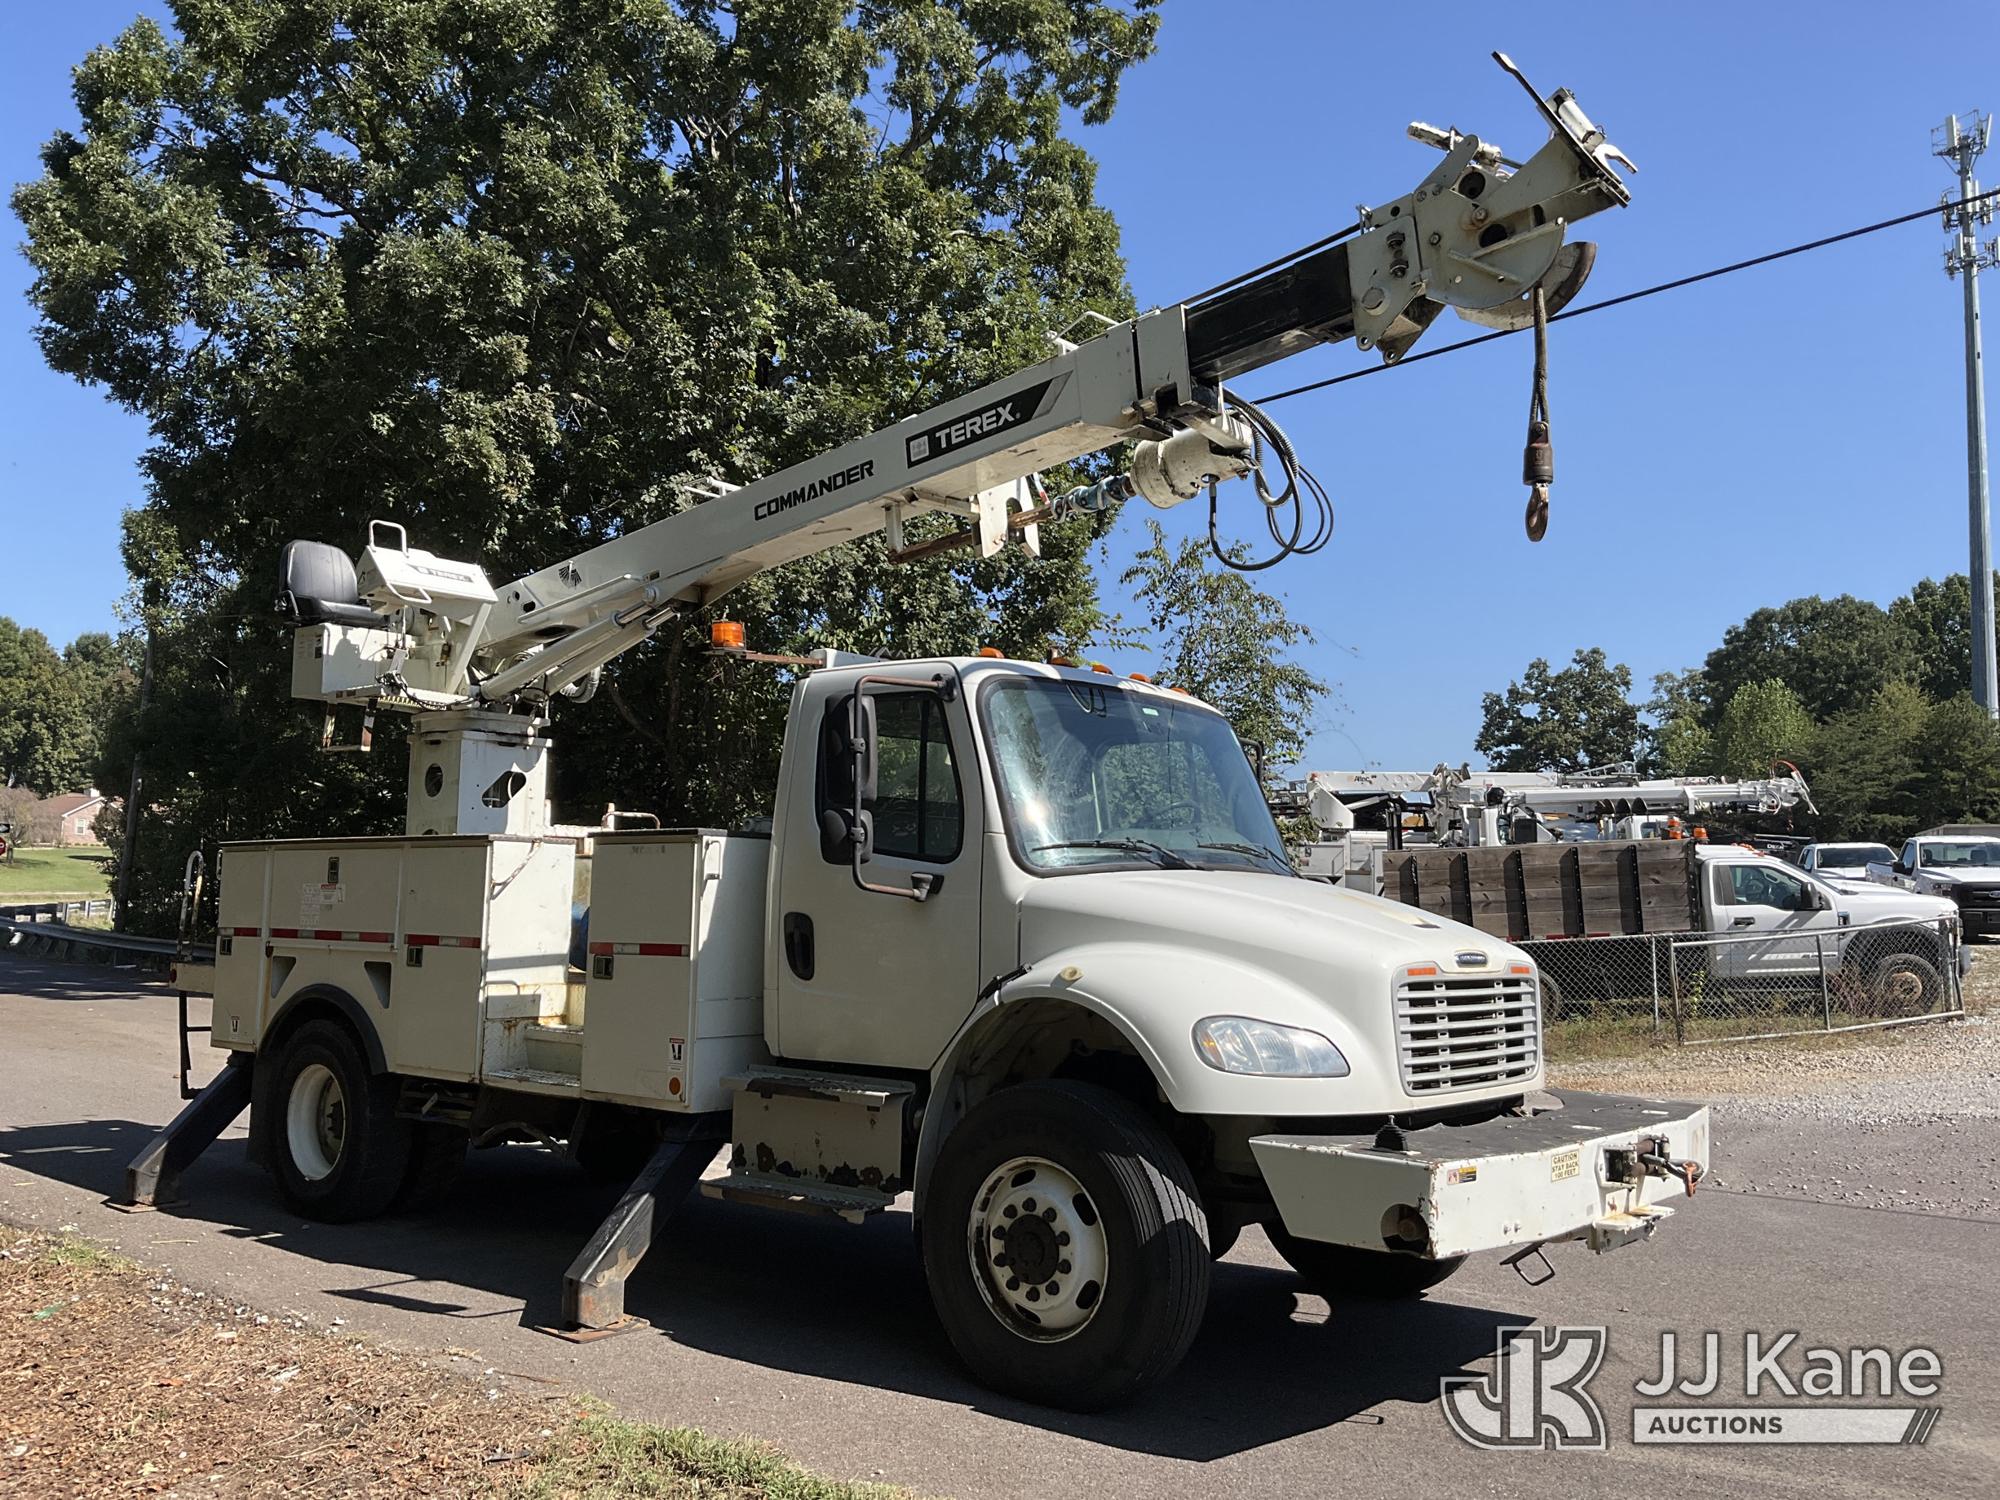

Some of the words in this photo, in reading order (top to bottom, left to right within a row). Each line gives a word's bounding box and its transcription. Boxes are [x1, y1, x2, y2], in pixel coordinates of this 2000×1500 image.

[934, 402, 1015, 450] TEREX
[753, 459, 875, 521] COMMANDER
[1553, 1153, 1577, 1164] CAUTION
[1552, 1164, 1565, 1172] STAY
[1565, 1161, 1578, 1169] BACK
[1555, 1171, 1564, 1179] 100
[1564, 1168, 1576, 1176] FEET
